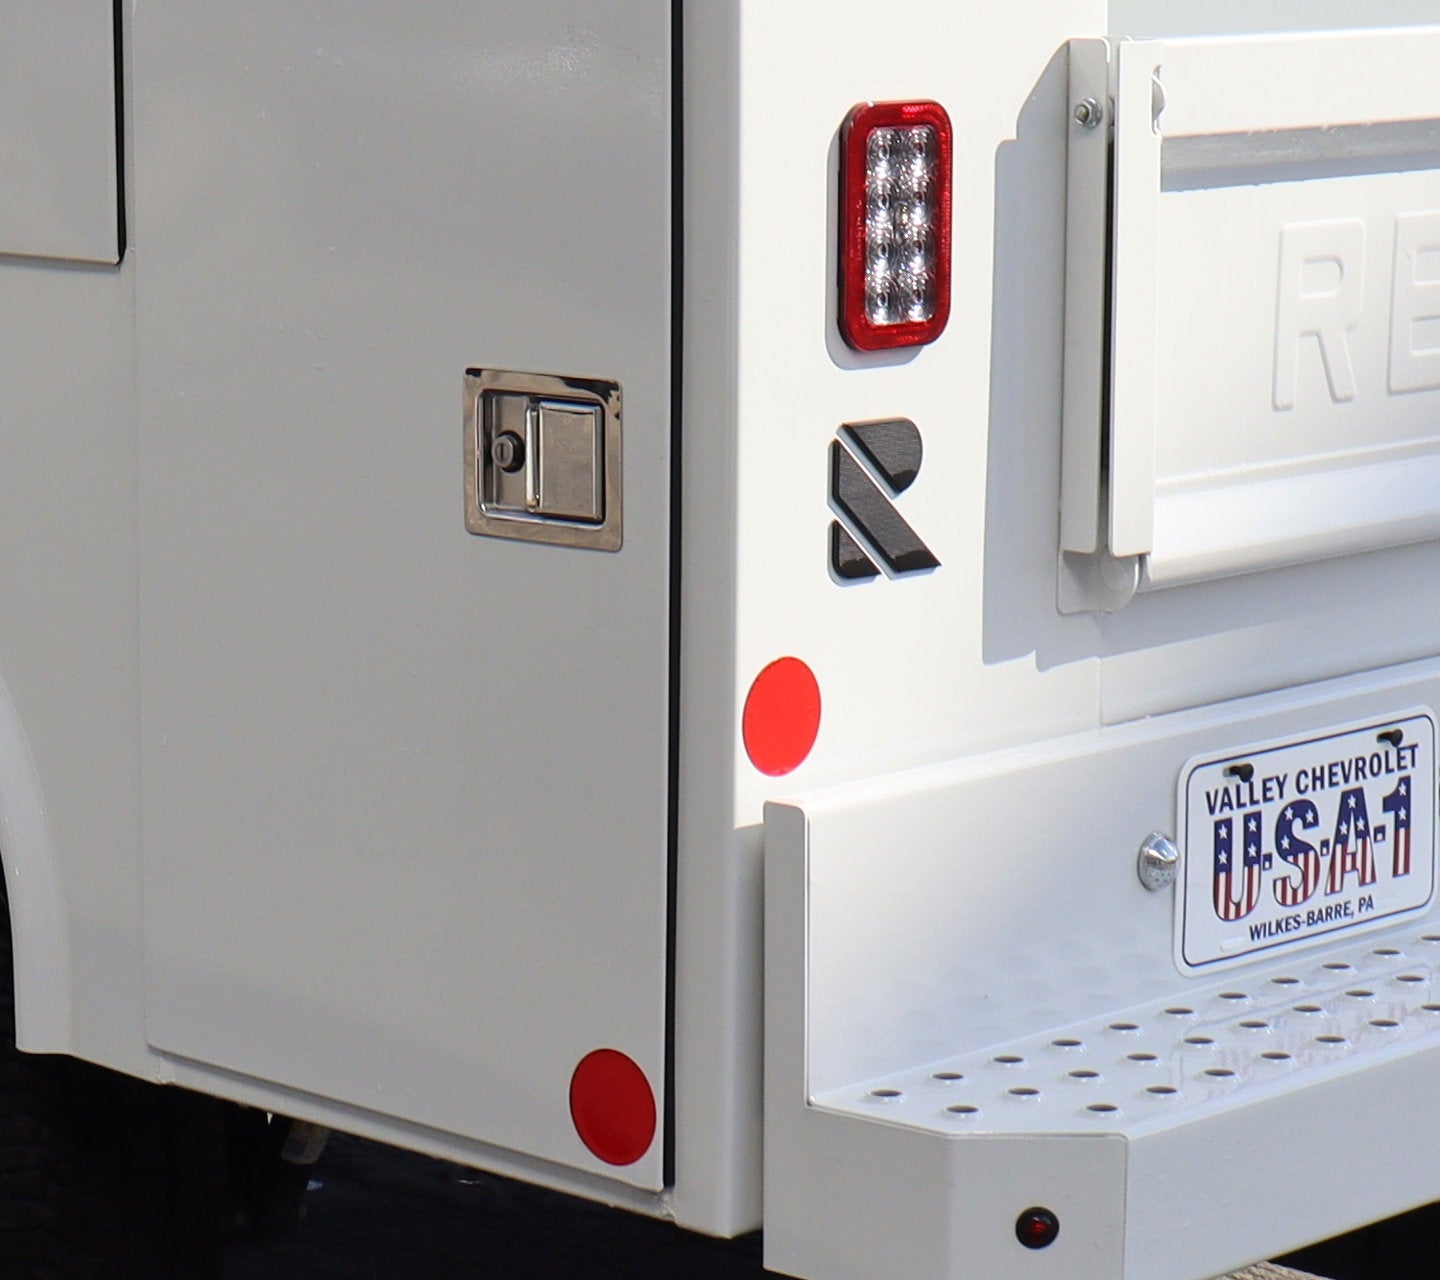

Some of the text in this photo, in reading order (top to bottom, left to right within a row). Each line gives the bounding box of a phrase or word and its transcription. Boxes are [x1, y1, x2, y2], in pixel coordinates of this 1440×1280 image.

[1204, 743, 1420, 816] VALLEY CHEVROLET
[1248, 894, 1374, 942] WILKES-BARRE, PA
